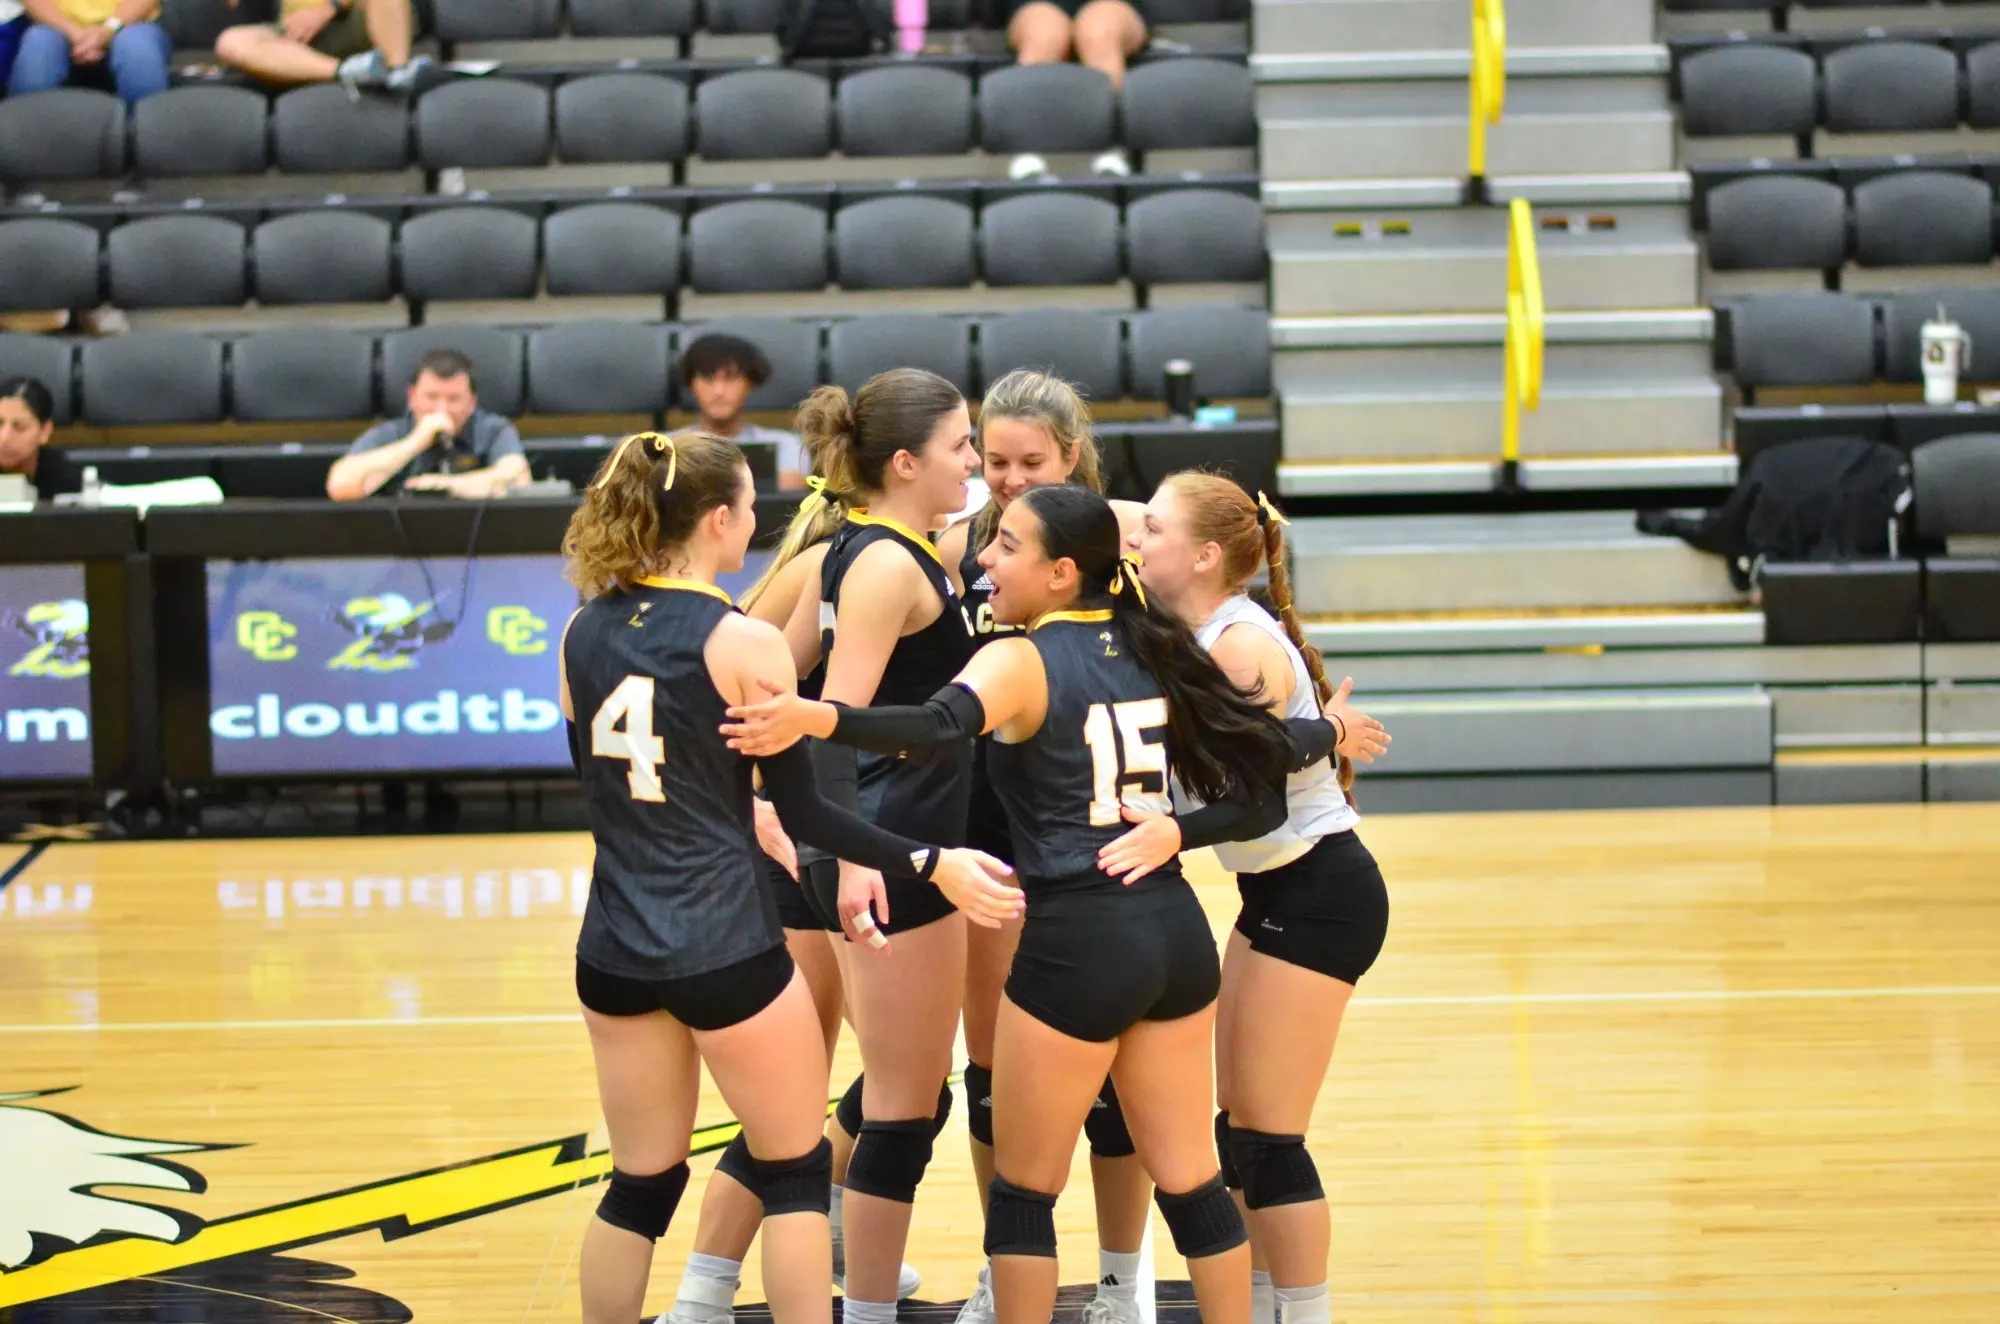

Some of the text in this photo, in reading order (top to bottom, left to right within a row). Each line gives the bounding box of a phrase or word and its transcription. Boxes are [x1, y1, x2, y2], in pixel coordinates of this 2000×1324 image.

[0, 708, 88, 742] m
[209, 688, 561, 739] cloudtb
[591, 674, 666, 803] 4
[1083, 698, 1173, 826] 15
